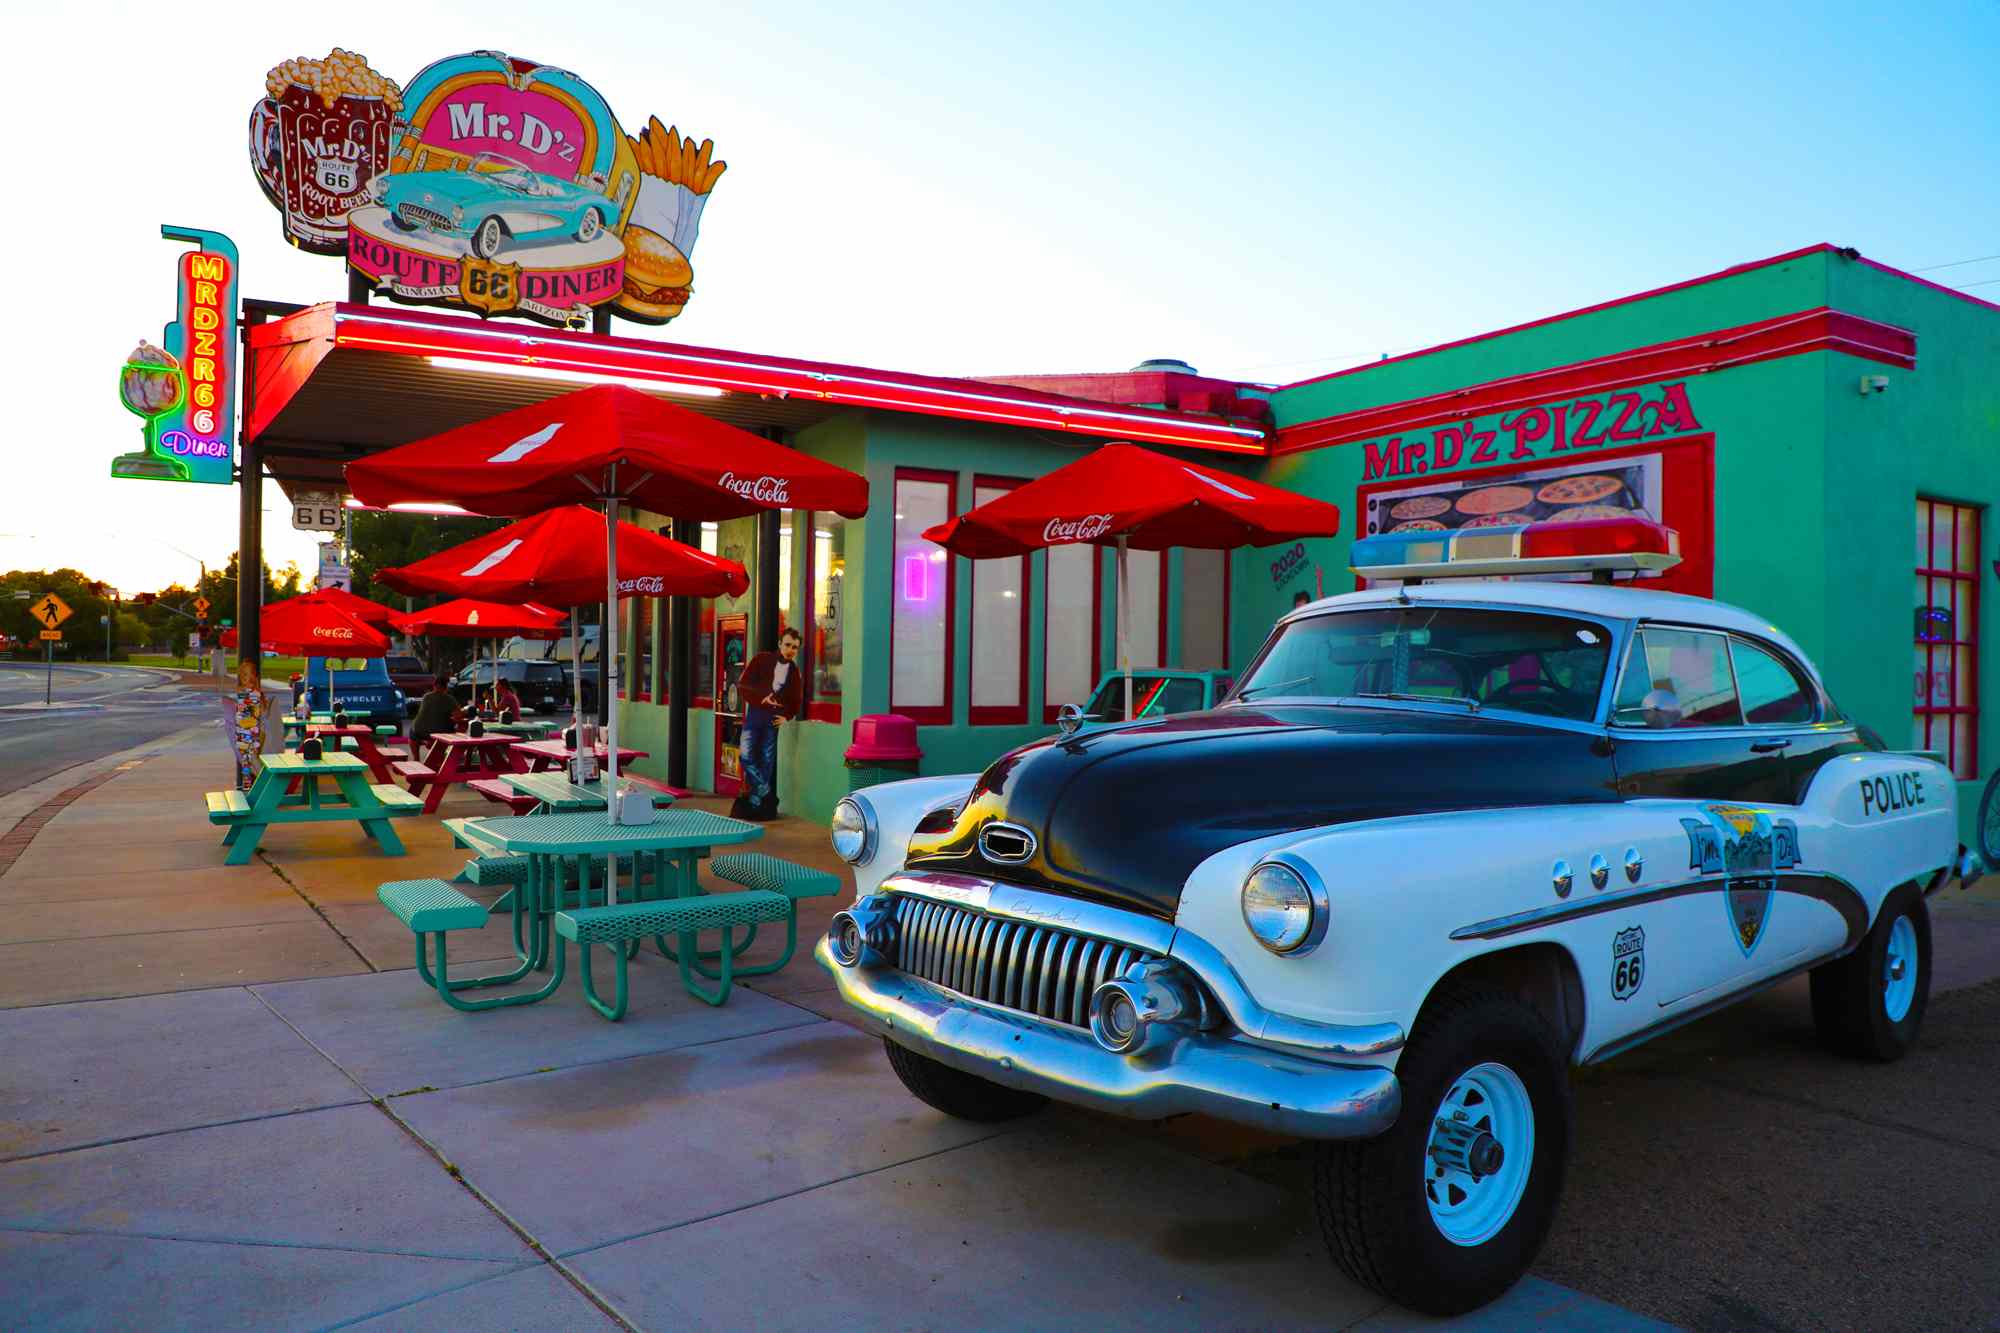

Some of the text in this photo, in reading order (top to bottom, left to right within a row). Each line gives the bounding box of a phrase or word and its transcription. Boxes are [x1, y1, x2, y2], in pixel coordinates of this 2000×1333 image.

[447, 102, 577, 162] Mr. D'z
[301, 136, 341, 159] Mr.
[322, 161, 351, 171] ROUTE
[325, 172, 349, 188] 66
[302, 182, 372, 208] ROOT BEER
[353, 237, 616, 299] ROUTE 66 DINER
[396, 285, 454, 297] KINGMAN
[160, 431, 228, 458] Diner
[1362, 382, 1704, 481] Mr. D'z PIZZA
[718, 471, 790, 504] Coca-Cola
[297, 507, 336, 525] 66
[1271, 543, 1305, 583] 2020
[614, 576, 665, 593] oca-Cola
[313, 626, 353, 639] Coca-Cola
[1860, 771, 1925, 816] POLICE
[1615, 938, 1641, 954] ROUTE
[1615, 956, 1640, 993] 66
